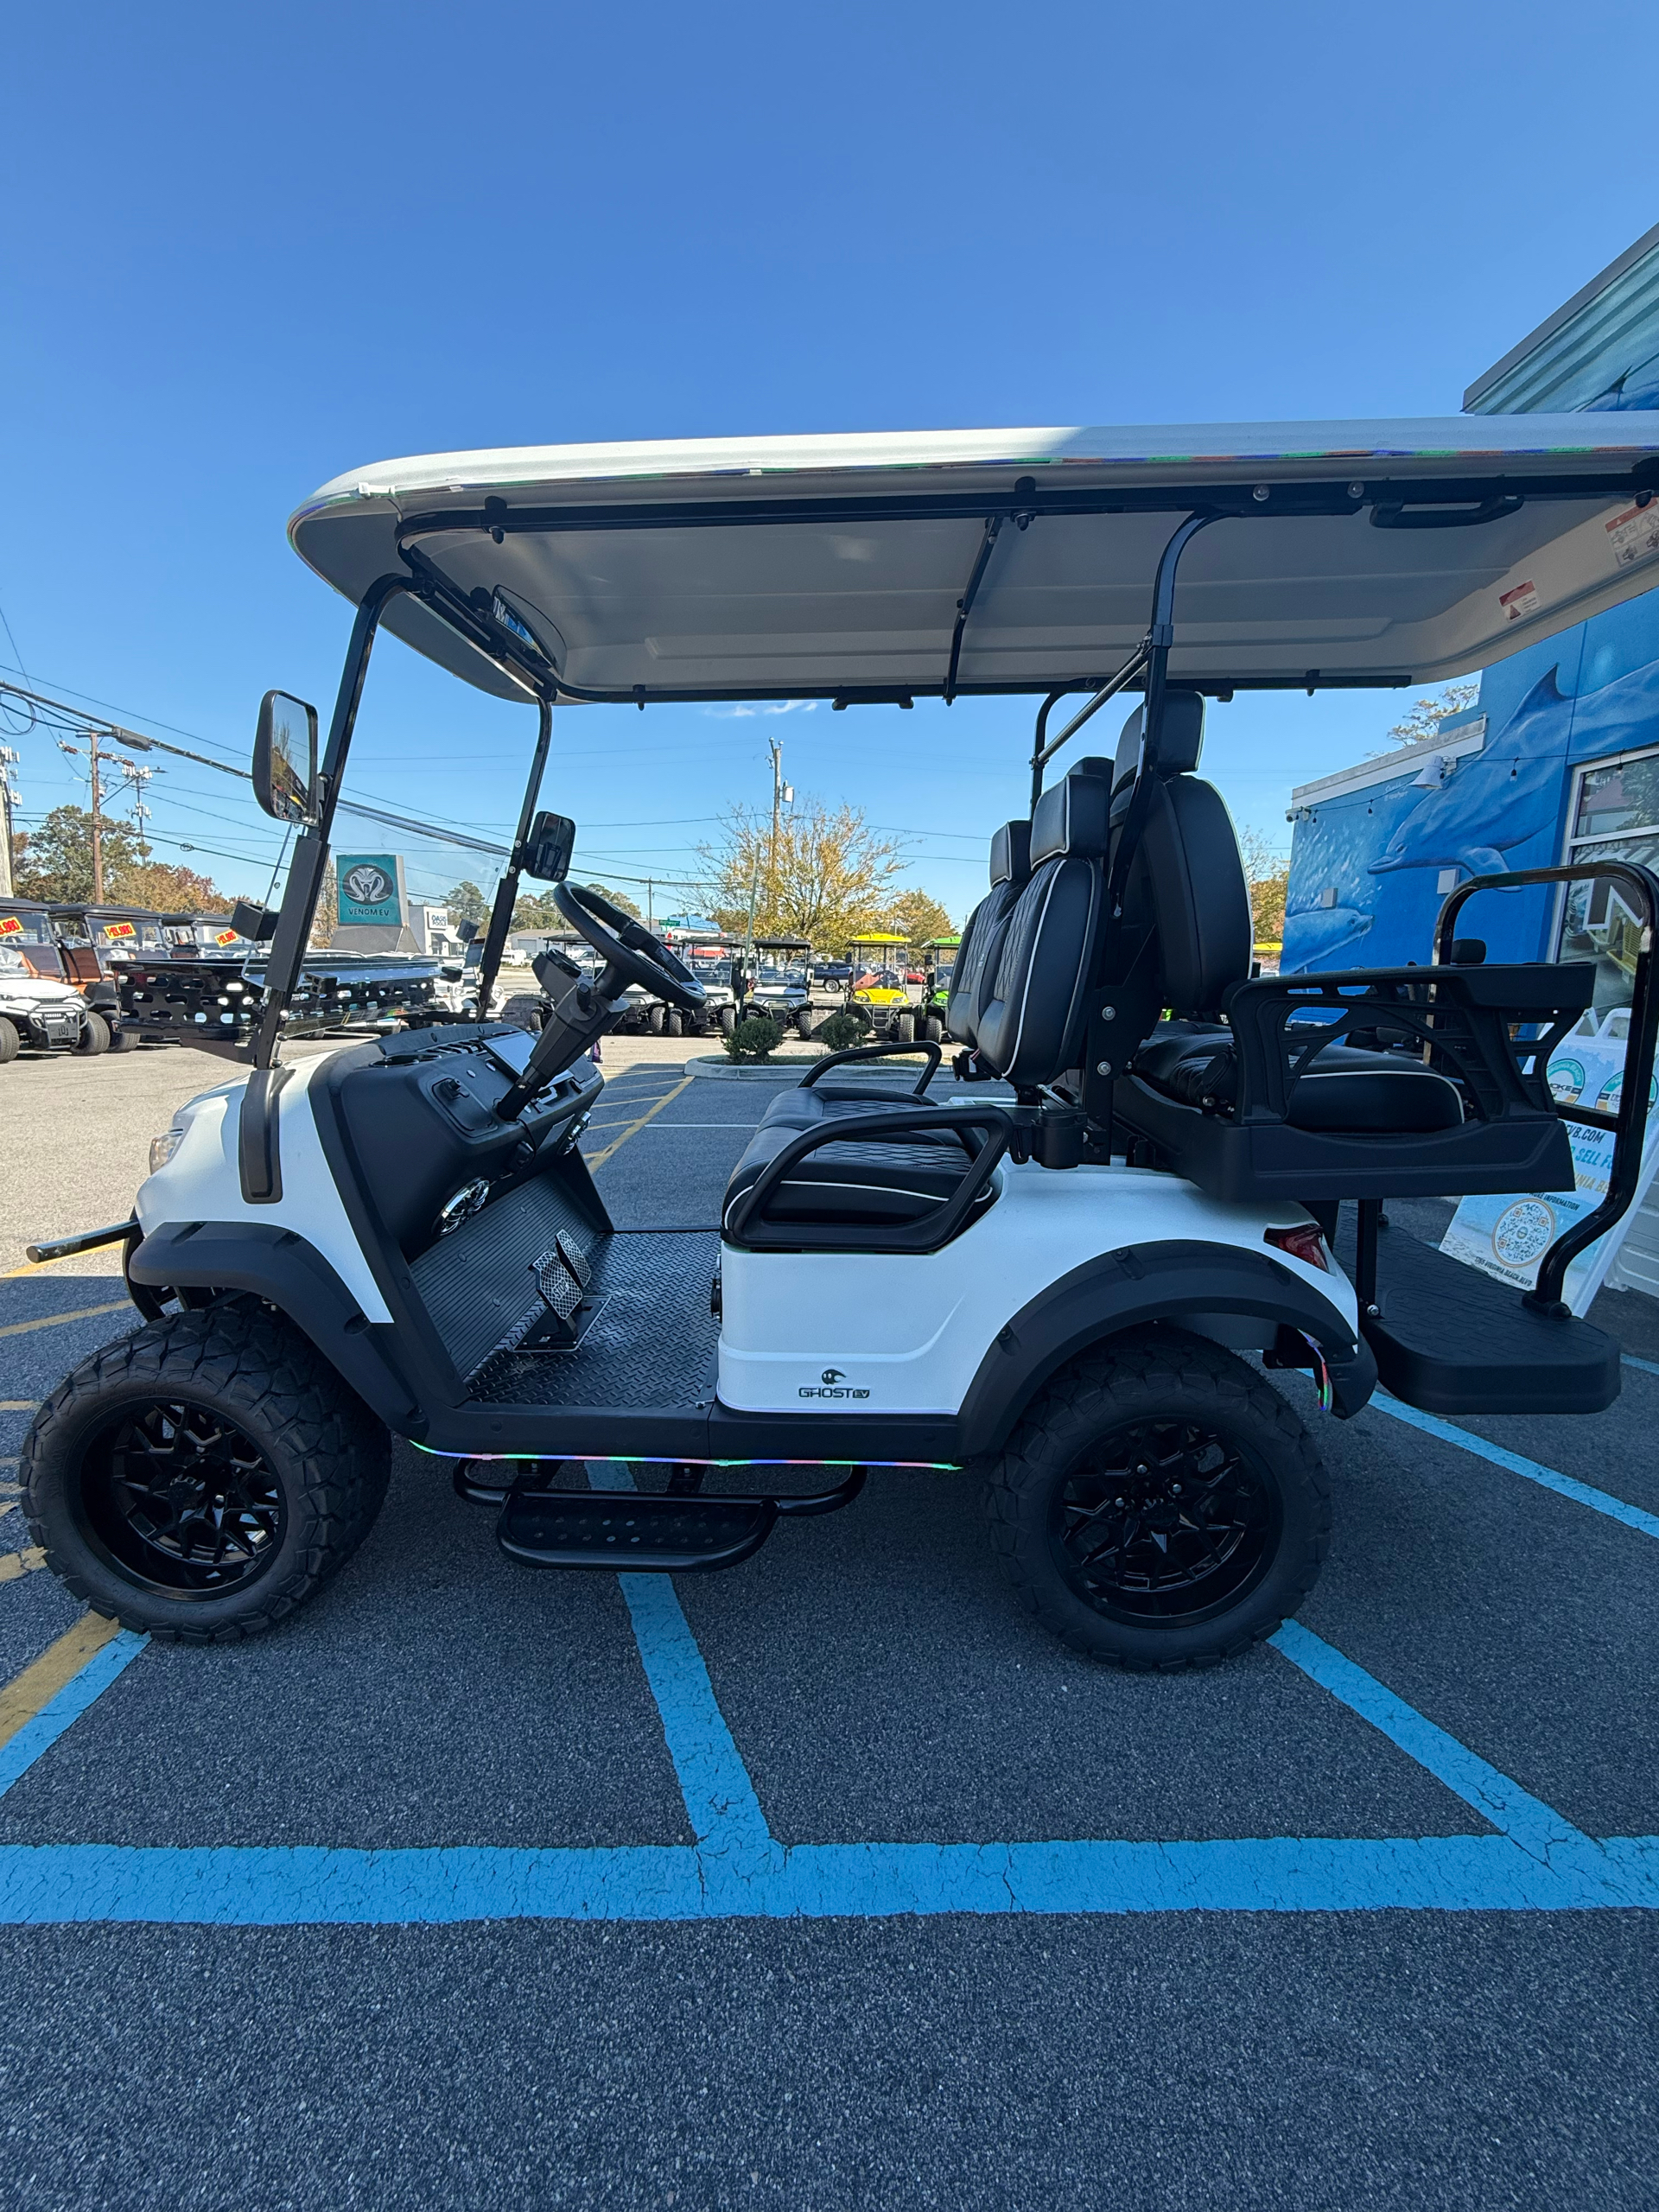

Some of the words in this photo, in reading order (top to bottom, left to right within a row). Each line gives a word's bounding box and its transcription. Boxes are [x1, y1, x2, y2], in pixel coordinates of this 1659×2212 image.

[1575, 1147, 1601, 1166] SELL
[1543, 1194, 1580, 1211] INFORMATION
[1484, 1260, 1505, 1275] VIRGINIA
[1503, 1268, 1521, 1281] BEACH
[1518, 1274, 1533, 1287] BLVD
[552, 1279, 568, 1299] STOP
[798, 1387, 853, 1399] GHOST
[853, 1389, 870, 1399] EV
